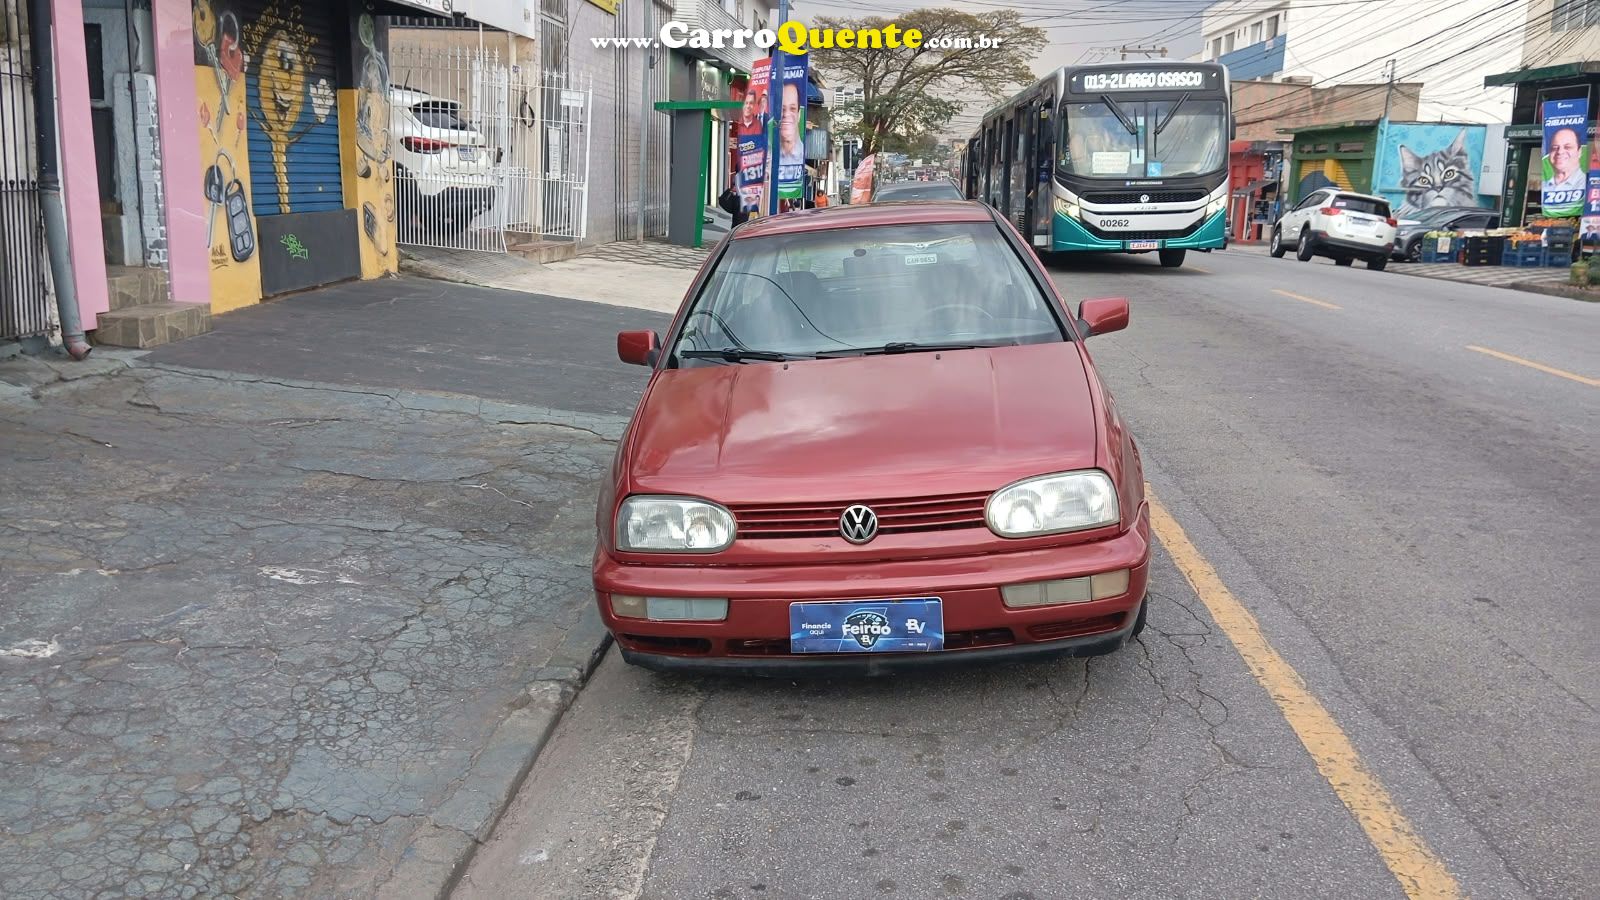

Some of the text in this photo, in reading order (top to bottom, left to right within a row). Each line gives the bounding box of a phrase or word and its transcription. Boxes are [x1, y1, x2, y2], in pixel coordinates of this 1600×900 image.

[1157, 71, 1203, 87] OSASCO
[1545, 118, 1584, 127] RIBAMAR
[1544, 190, 1583, 203] 2019
[1099, 219, 1130, 228] 00262
[842, 621, 891, 636] Feirão
